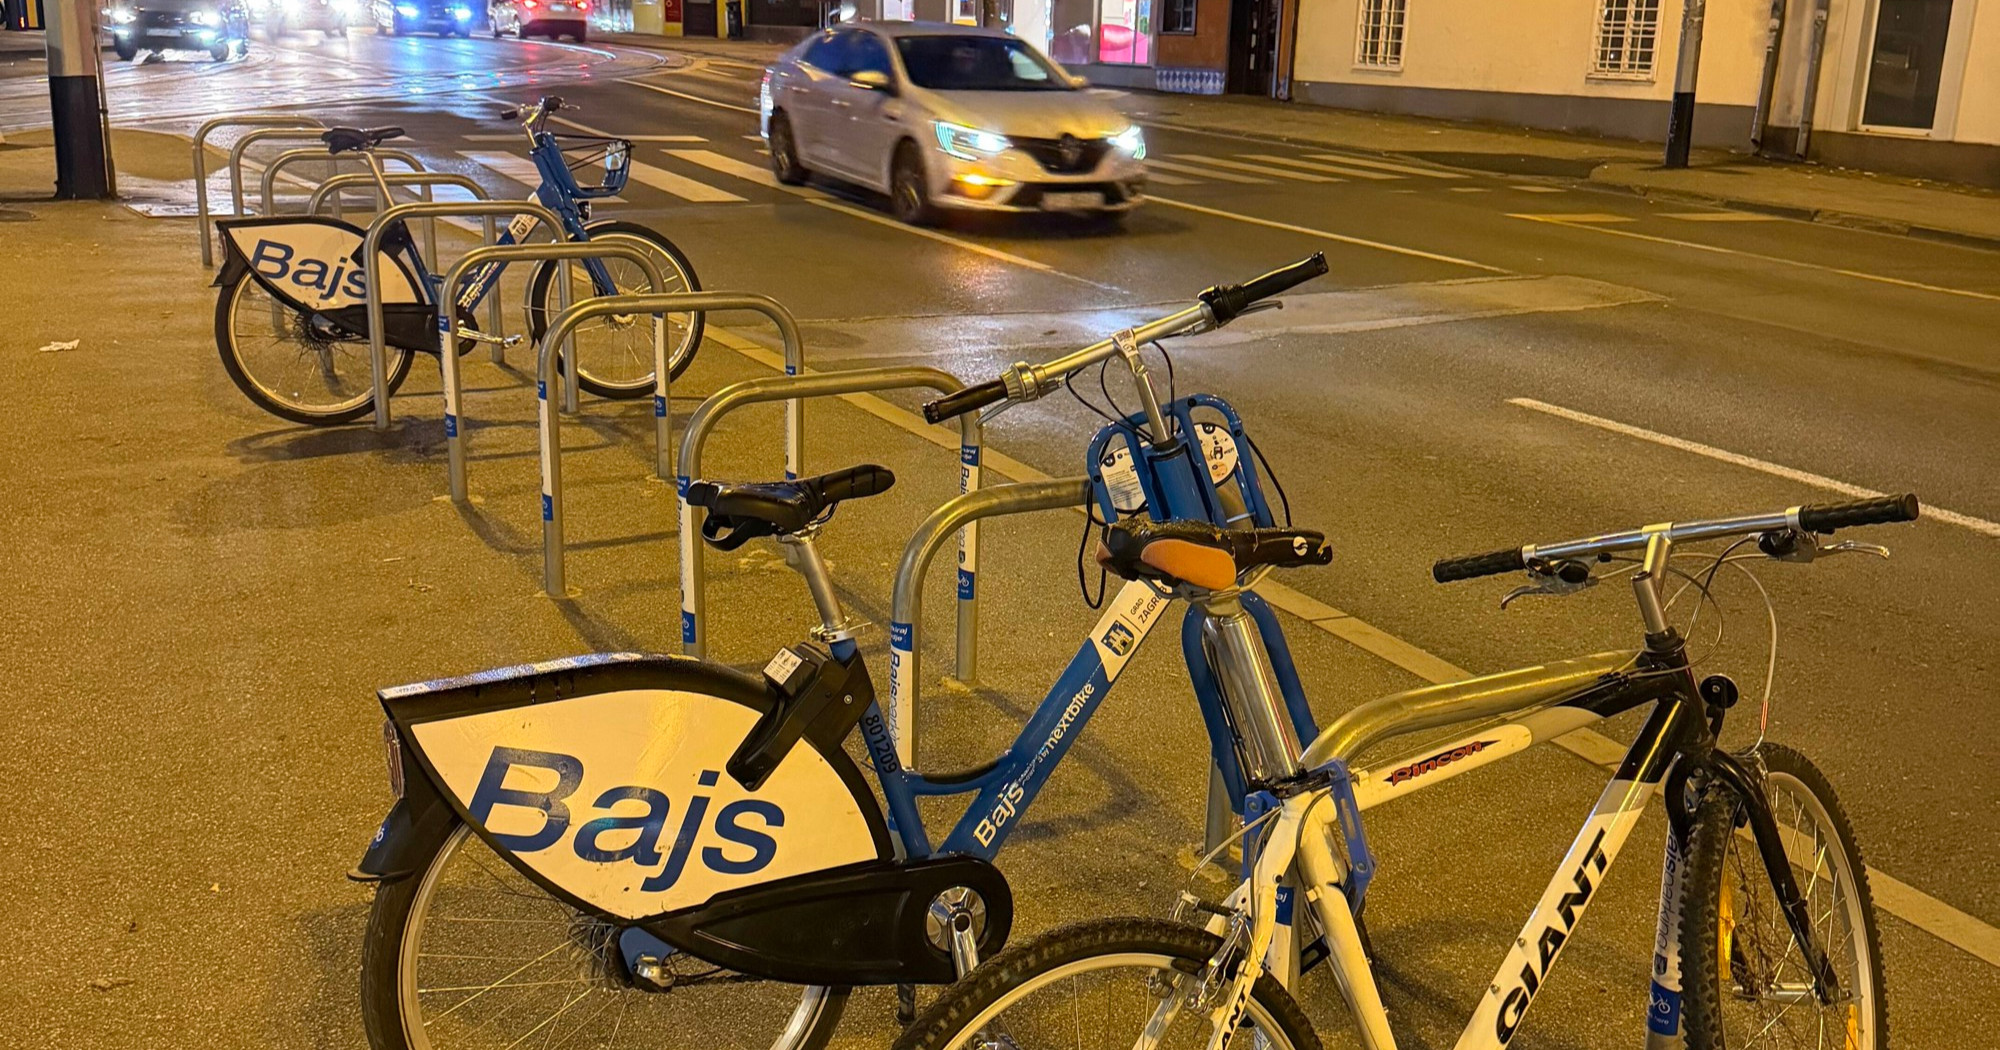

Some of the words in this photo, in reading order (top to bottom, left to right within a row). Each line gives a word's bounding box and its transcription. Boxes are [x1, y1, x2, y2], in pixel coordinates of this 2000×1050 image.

[252, 239, 367, 300] Bajs
[1130, 597, 1144, 615] GRAD
[865, 714, 898, 774] 801209
[973, 781, 1025, 848] Bajs
[1046, 682, 1095, 751] nextbike
[1391, 741, 1483, 786] Rincon
[468, 746, 785, 892] Bajs
[1496, 827, 1608, 1045] GIANT
[1656, 827, 1682, 952] ajsparking
